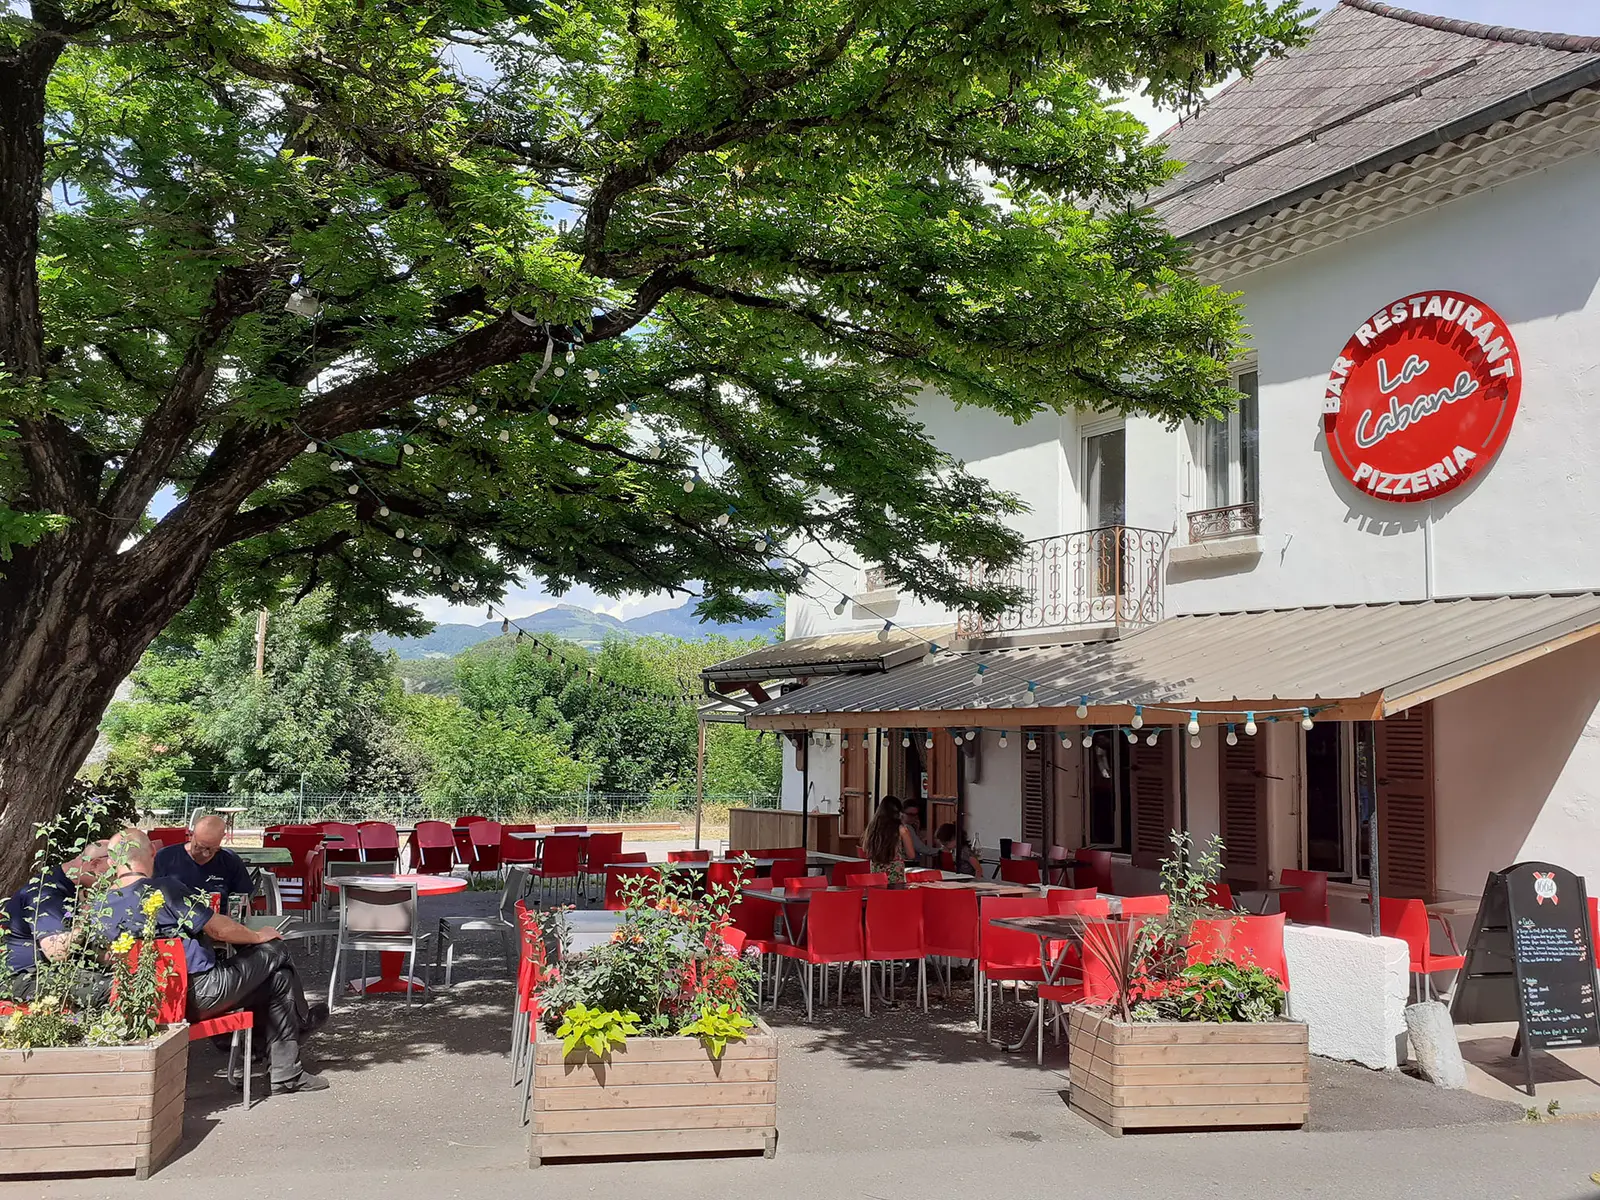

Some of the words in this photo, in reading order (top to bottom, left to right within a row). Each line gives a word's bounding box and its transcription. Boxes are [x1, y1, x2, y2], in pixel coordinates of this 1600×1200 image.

[1323, 355, 1354, 414] BAR
[1354, 296, 1515, 378] RESTAURANT
[1377, 354, 1430, 394] La
[1355, 371, 1479, 449] Cabane
[1352, 445, 1477, 495] PIZZERIA
